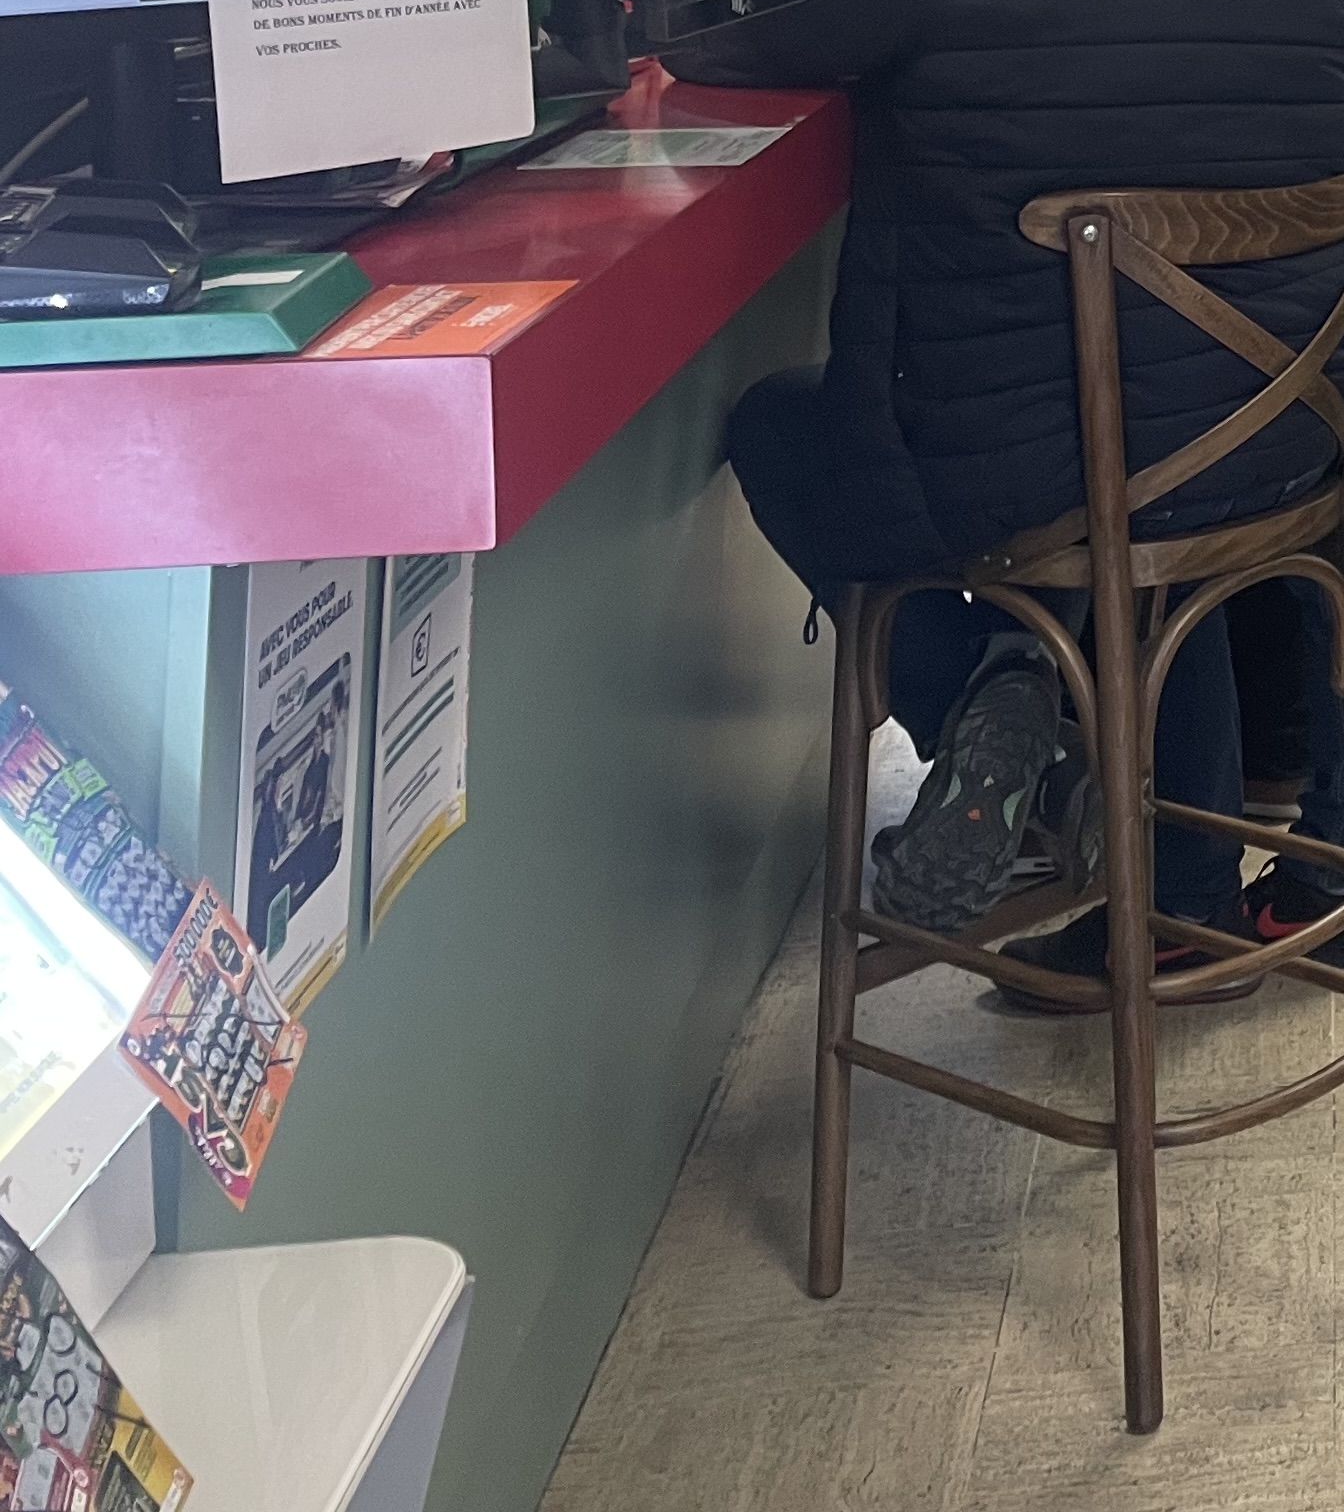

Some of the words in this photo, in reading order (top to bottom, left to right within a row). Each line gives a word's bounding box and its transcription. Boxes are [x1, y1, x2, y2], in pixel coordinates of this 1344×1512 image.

[253, 19, 271, 30] DE
[273, 16, 305, 29] BONS
[308, 10, 364, 26] MOMENTS
[367, 9, 382, 20] DE
[385, 7, 402, 18] FIN
[256, 44, 280, 57] VOS
[286, 602, 310, 637] VOUS
[311, 581, 336, 616] POUR
[258, 661, 272, 689] UN
